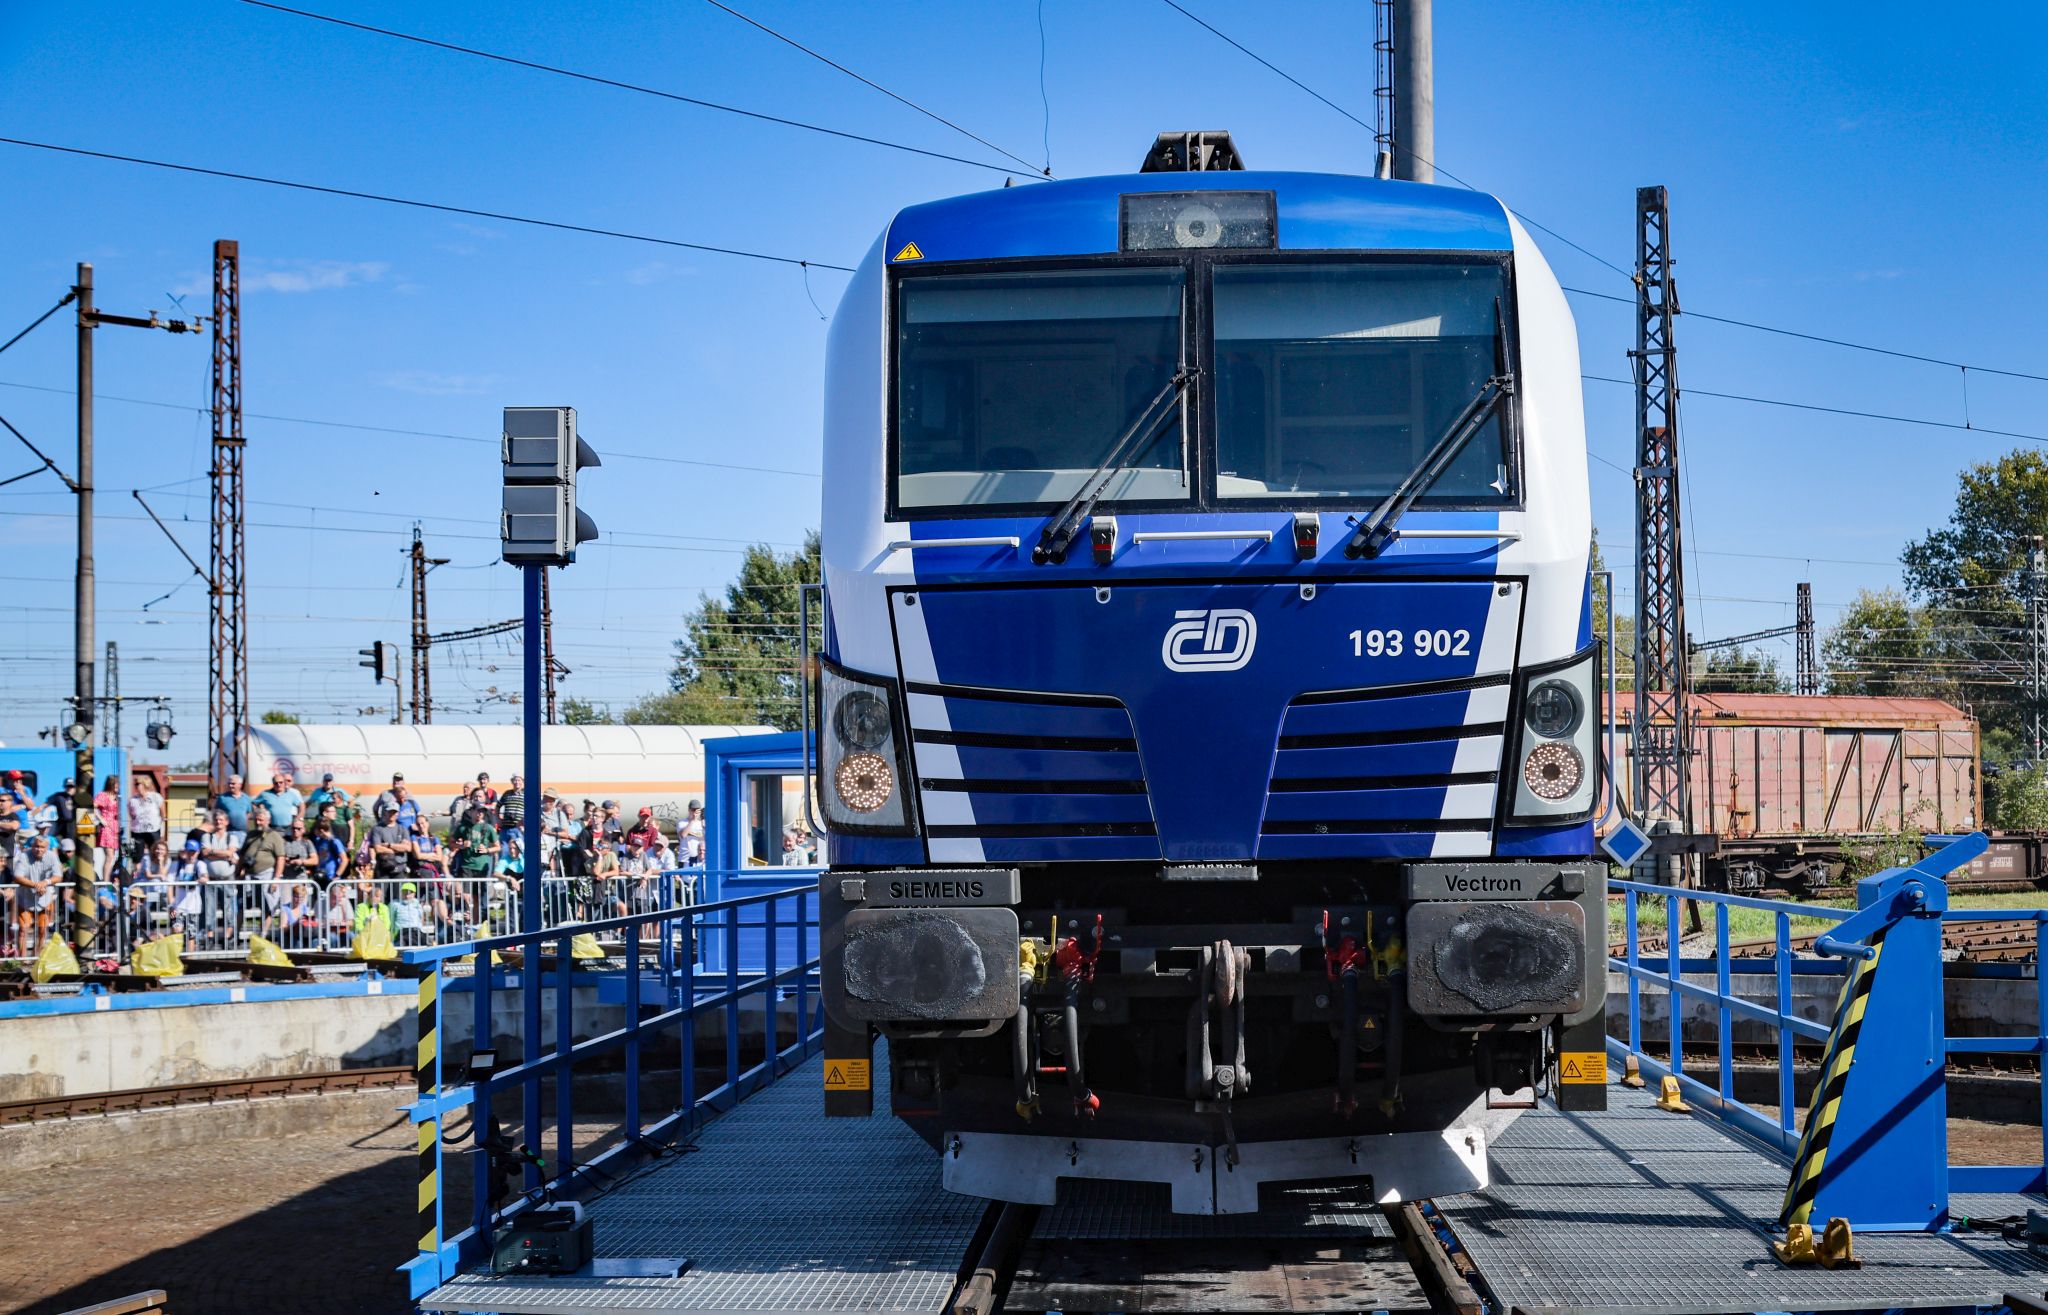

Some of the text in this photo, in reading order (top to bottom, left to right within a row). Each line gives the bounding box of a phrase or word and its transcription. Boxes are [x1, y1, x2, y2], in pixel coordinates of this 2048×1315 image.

[1349, 629, 1470, 657] 193 902
[302, 762, 370, 774] ermewa
[1444, 875, 1521, 892] Vectron
